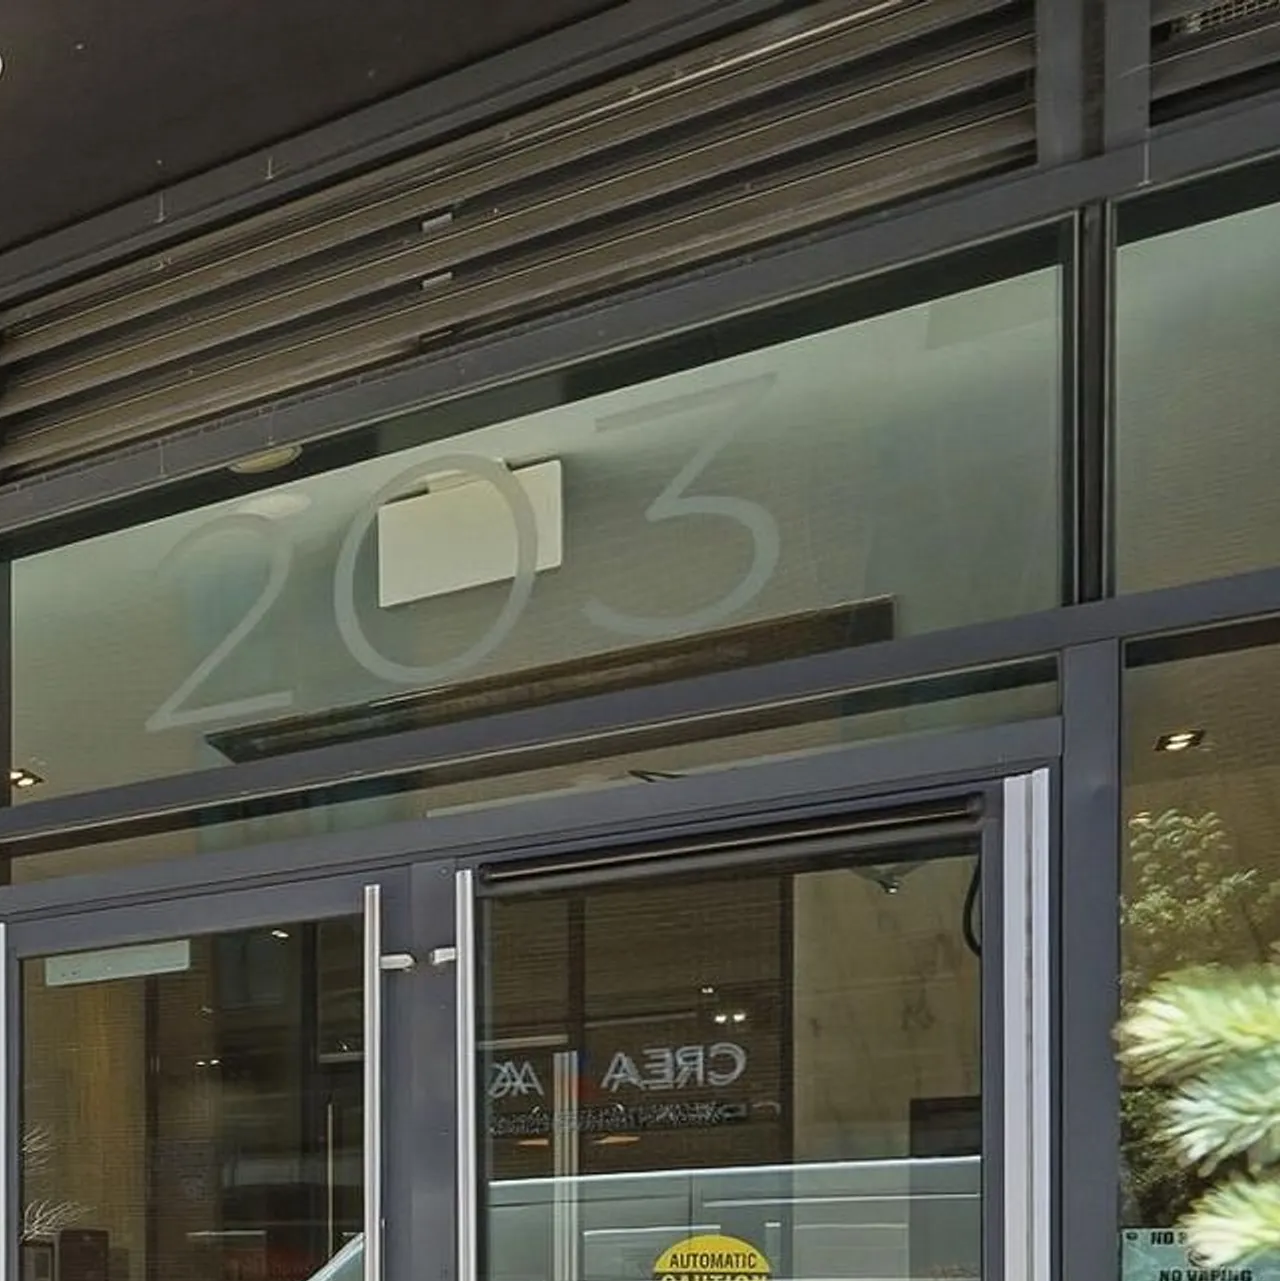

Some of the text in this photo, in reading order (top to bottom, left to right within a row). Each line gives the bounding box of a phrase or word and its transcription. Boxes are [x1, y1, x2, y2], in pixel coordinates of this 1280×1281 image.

[143, 368, 782, 733] 203
[1151, 1231, 1174, 1245] NO
[669, 1252, 757, 1270] AUTOMATIC
